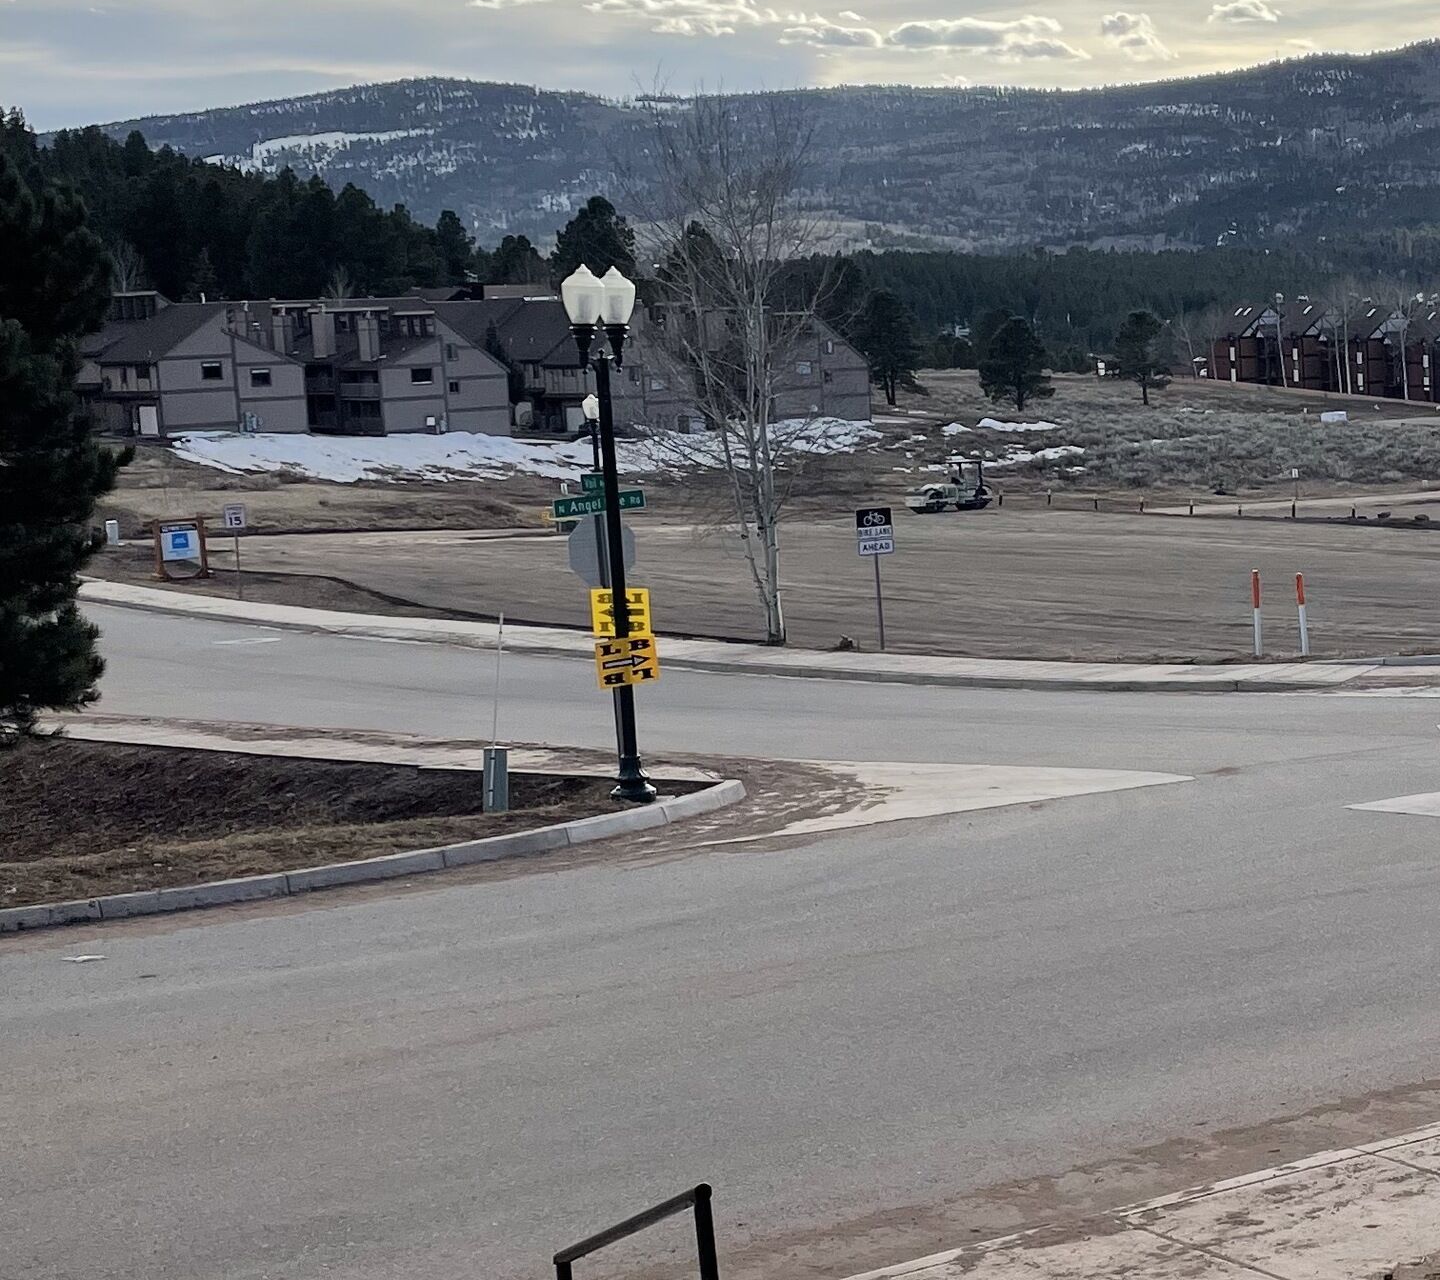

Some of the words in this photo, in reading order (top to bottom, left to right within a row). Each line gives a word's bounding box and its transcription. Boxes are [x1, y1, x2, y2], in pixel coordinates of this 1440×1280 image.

[570, 497, 602, 514] Angel
[229, 516, 242, 526] 15
[863, 542, 890, 552] AHEAD
